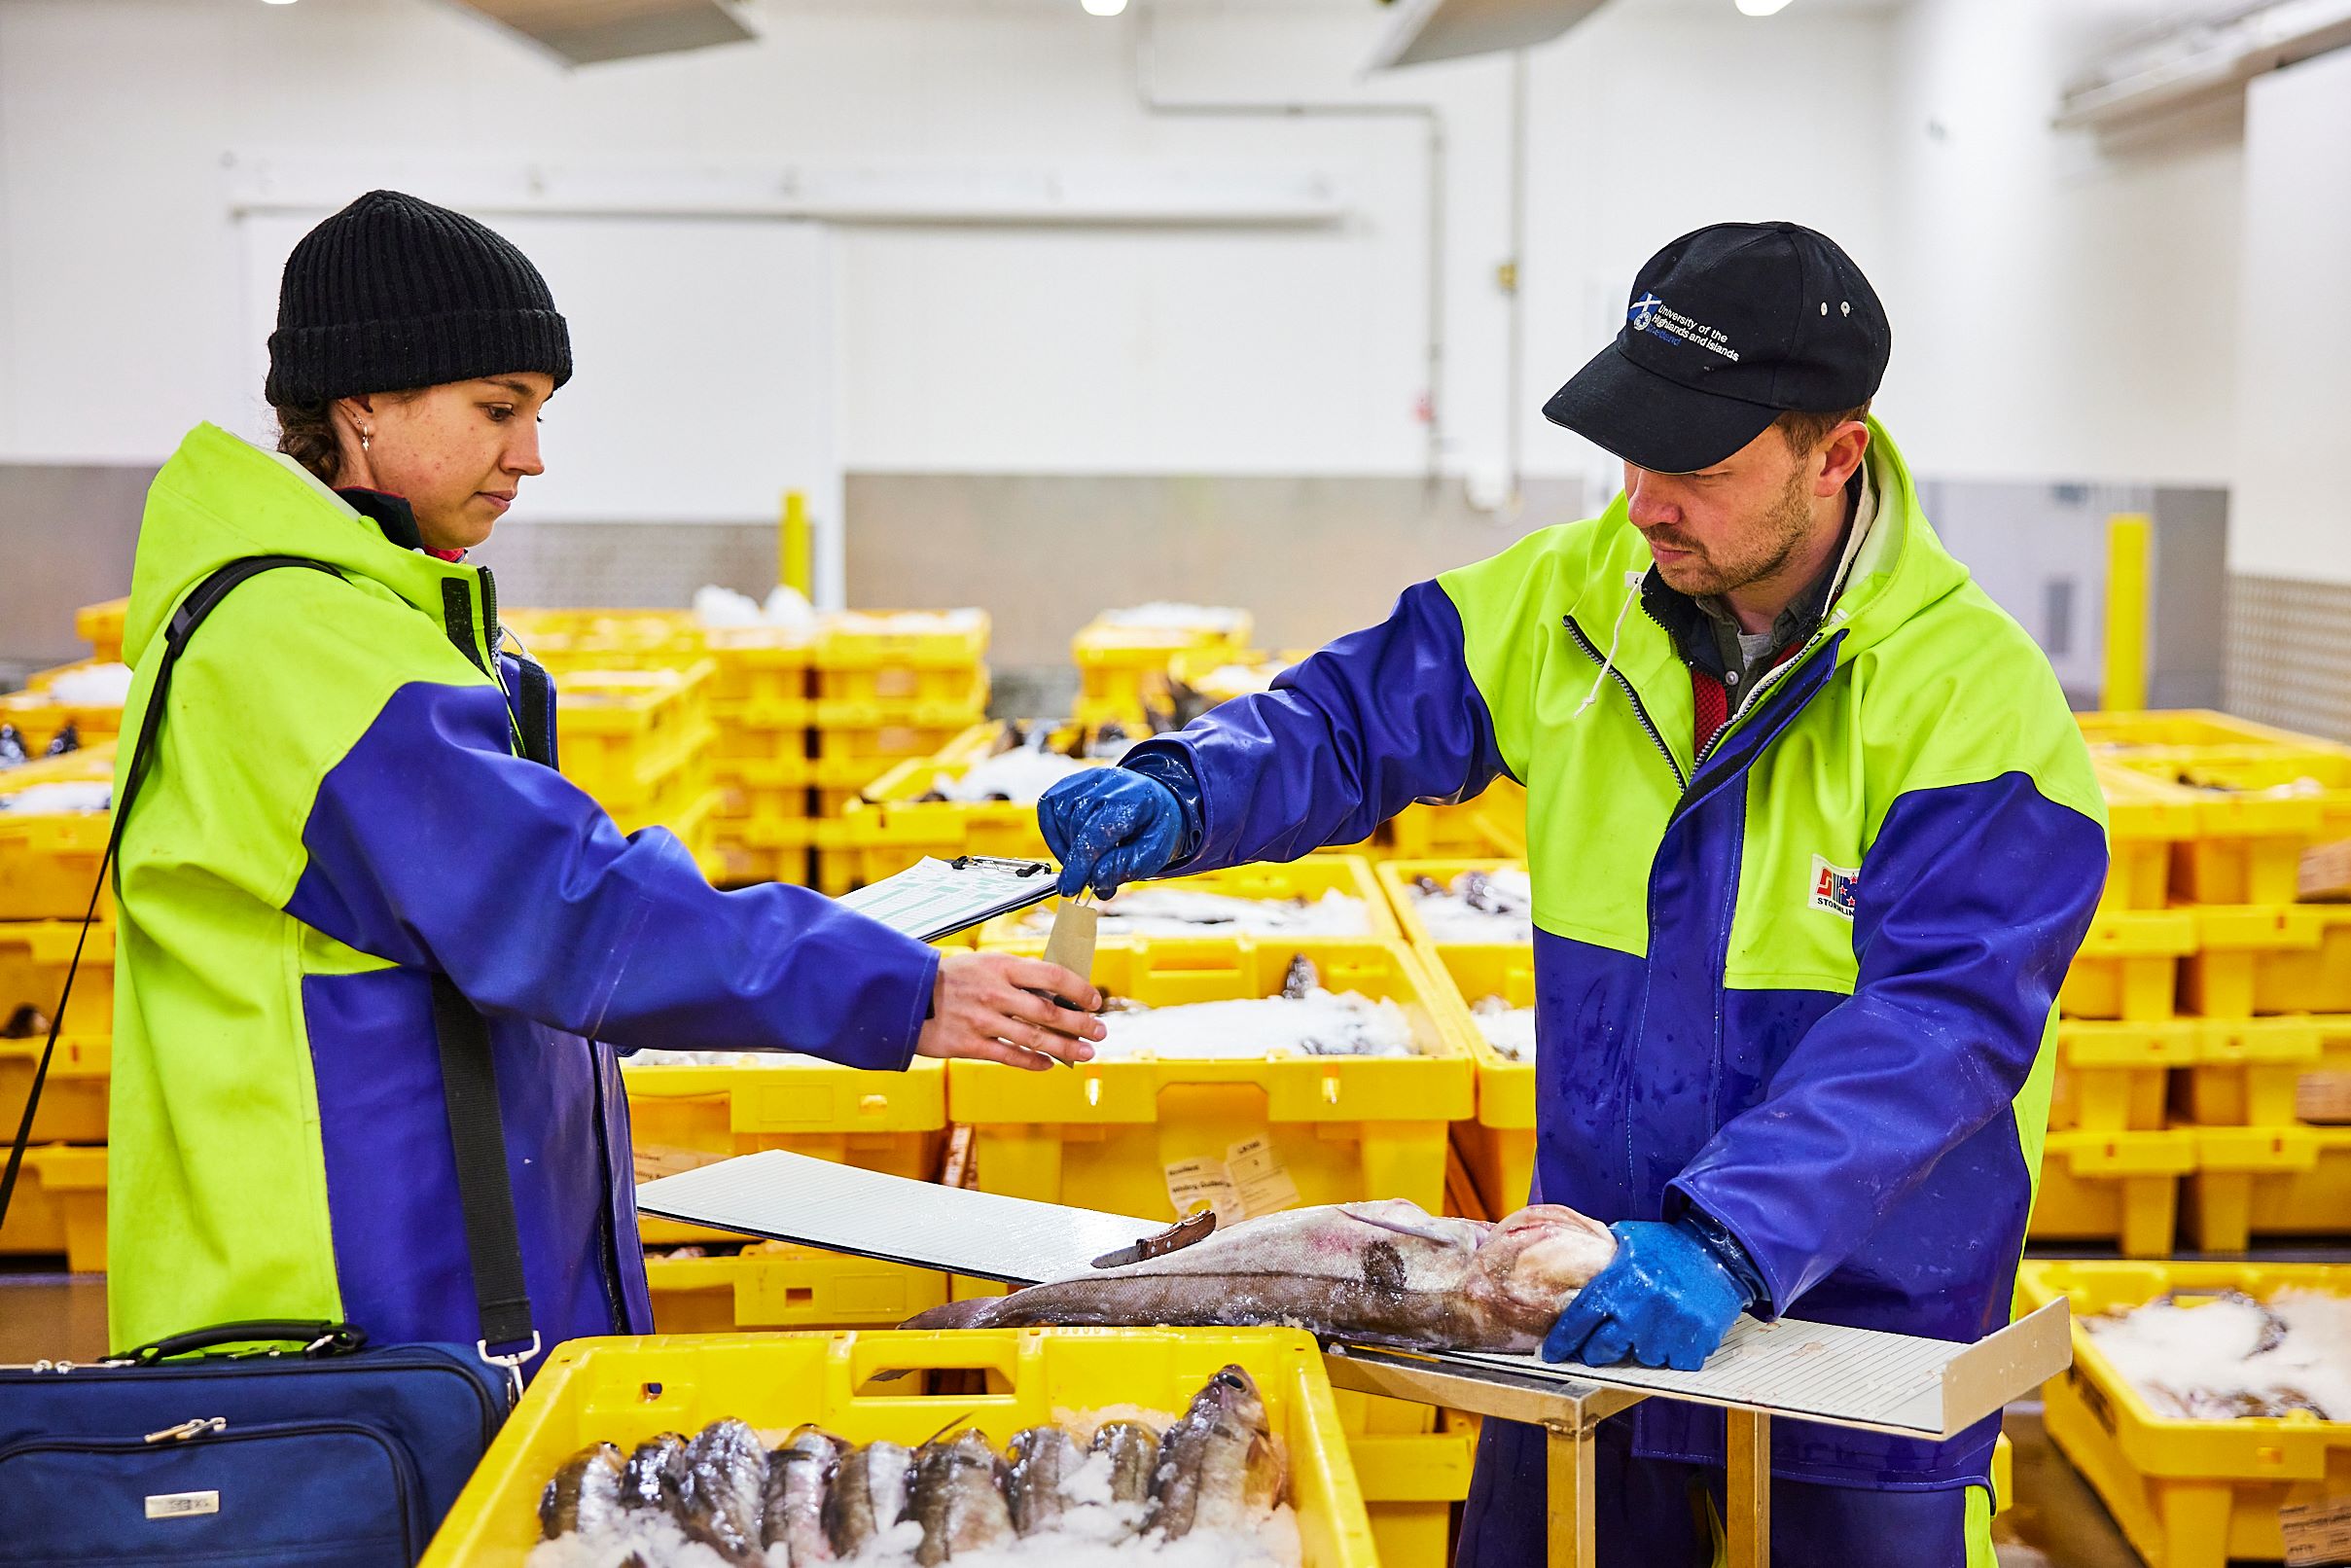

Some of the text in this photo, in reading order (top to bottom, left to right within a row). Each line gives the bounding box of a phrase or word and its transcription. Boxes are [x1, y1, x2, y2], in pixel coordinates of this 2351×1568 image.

[1652, 313, 1740, 363] Highlands and Islands
[1657, 303, 1728, 343] University of the
[1817, 897, 1855, 916] STORMLIN
